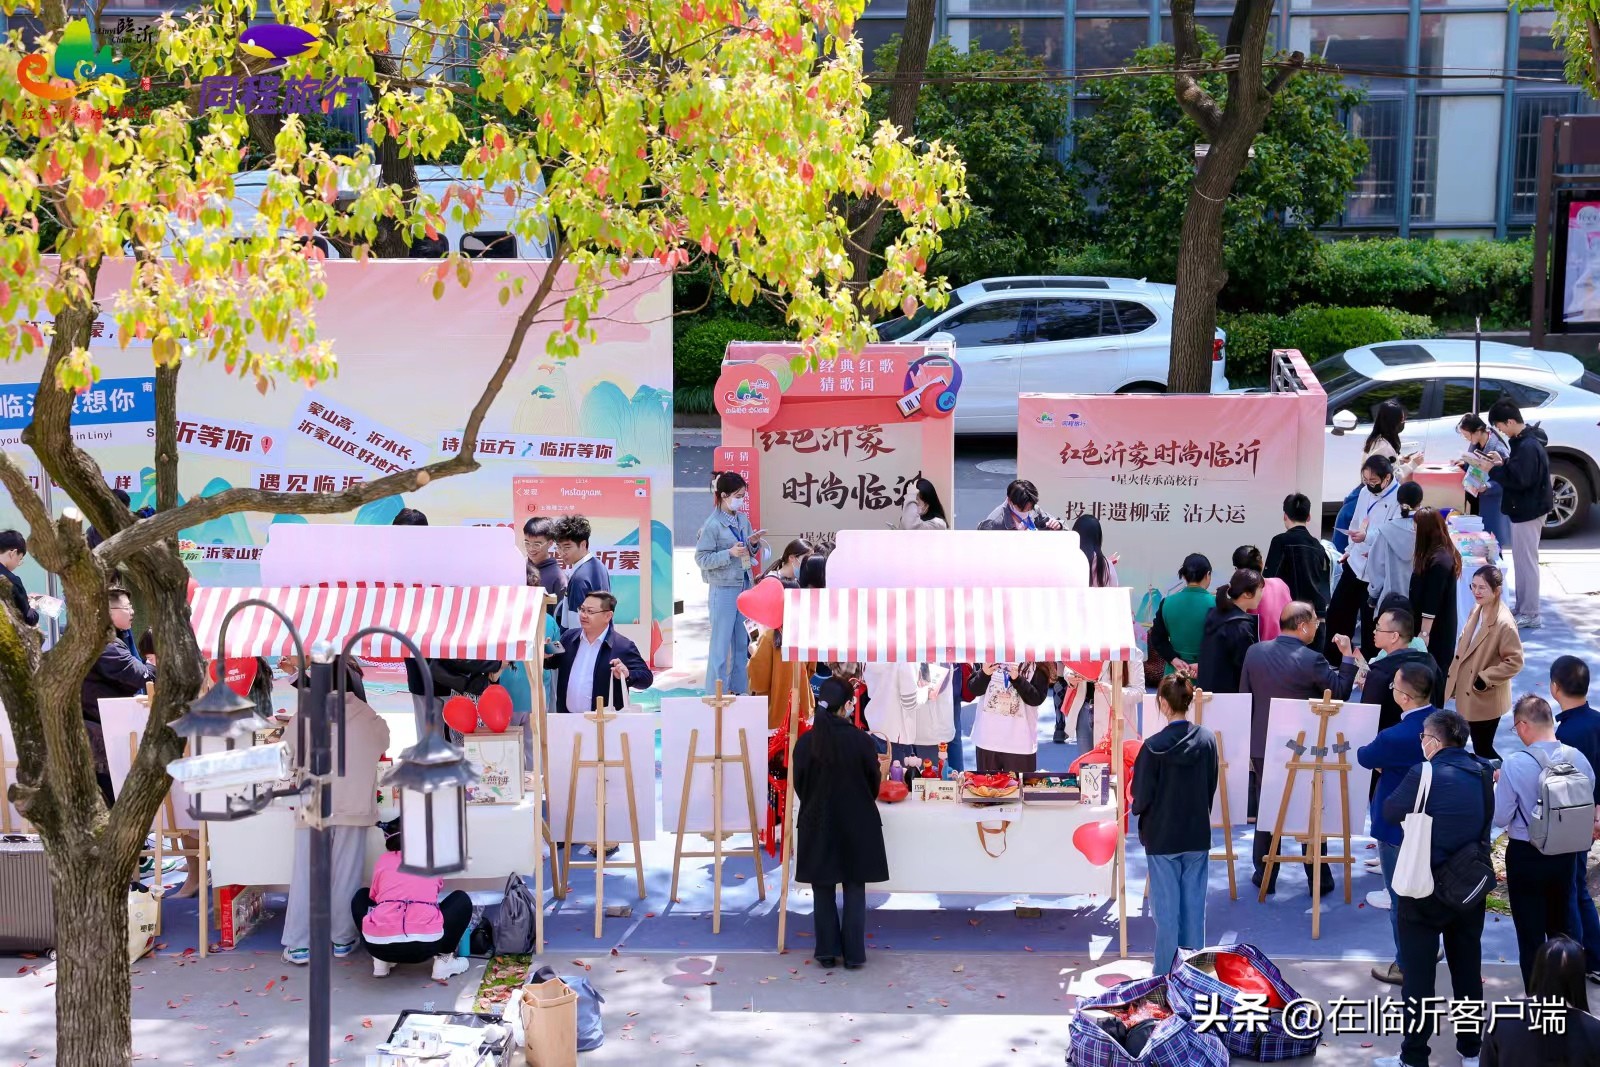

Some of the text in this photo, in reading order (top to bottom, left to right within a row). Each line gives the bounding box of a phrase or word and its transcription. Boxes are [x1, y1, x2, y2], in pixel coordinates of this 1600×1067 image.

[141, 382, 153, 393] 南
[819, 377, 875, 392] 猜歌词
[1, 437, 19, 446] you
[77, 432, 86, 440] in
[88, 430, 113, 440] Linyi
[442, 437, 613, 460] 诗远方 临沂等你
[724, 451, 735, 474] 听一
[1059, 439, 1261, 479] 红色沂蒙时尚临沂
[1116, 474, 1199, 487] 星火传承高校行
[560, 488, 602, 500] Instagram
[1065, 500, 1246, 523] 投非遗柳壶 沾大运
[197, 547, 264, 560] 沂蒙山好
